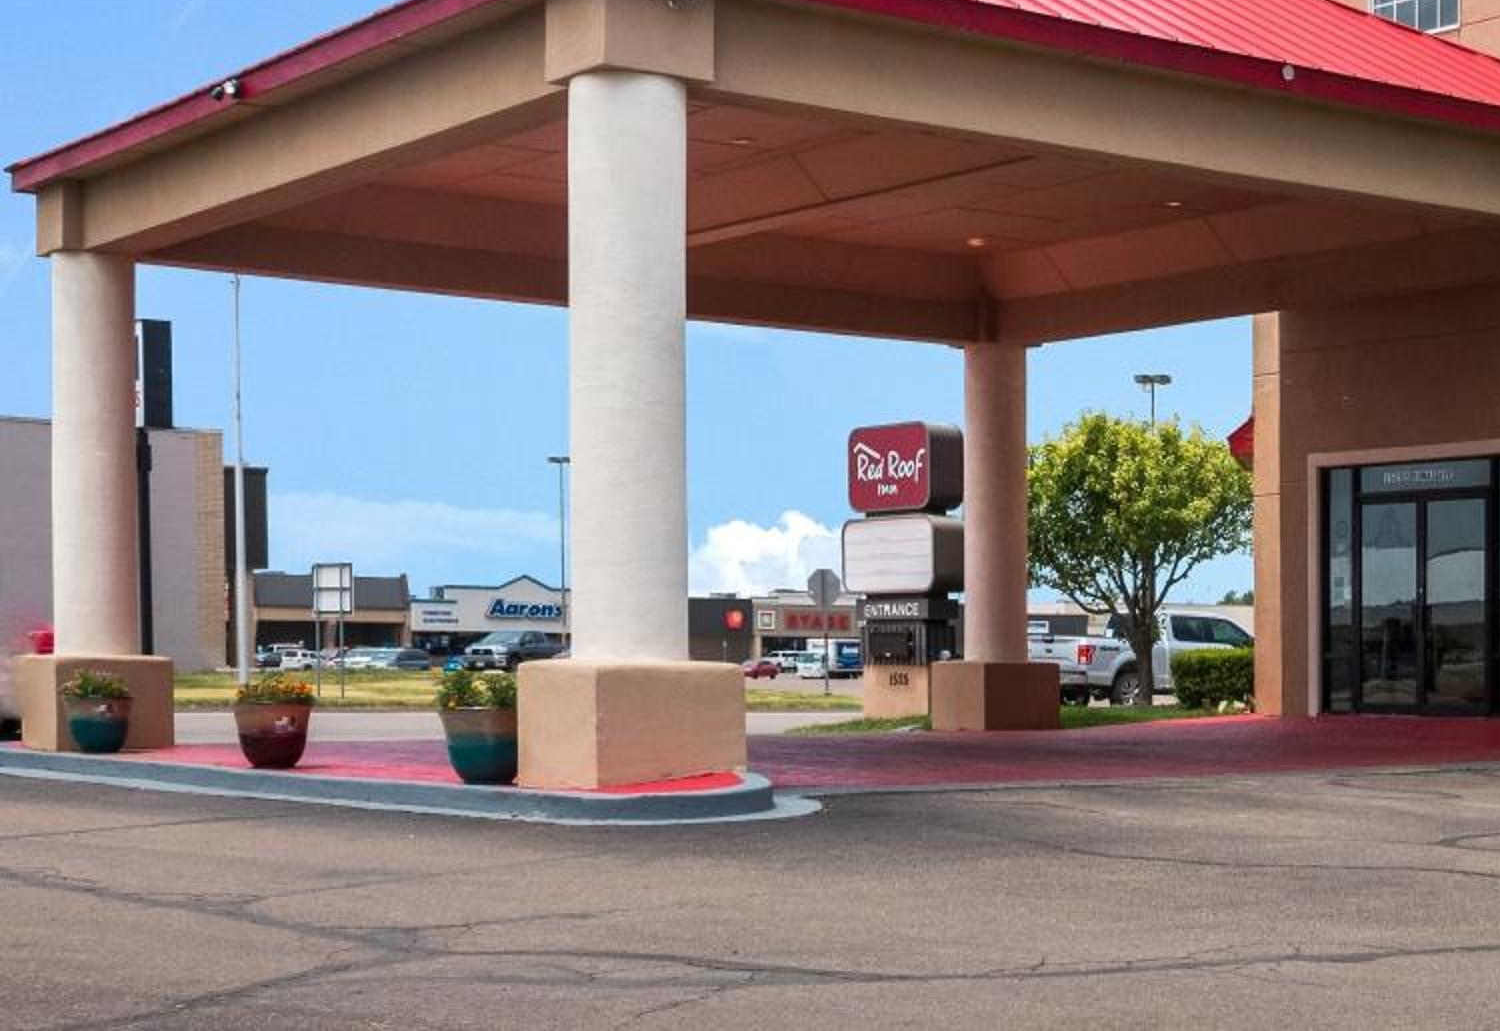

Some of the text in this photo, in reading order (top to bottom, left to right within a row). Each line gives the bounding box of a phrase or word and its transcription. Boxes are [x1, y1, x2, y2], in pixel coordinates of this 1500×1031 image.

[857, 448, 925, 483] Red Roof
[489, 598, 563, 618] Aaron's
[864, 602, 920, 619] ENTRANCE
